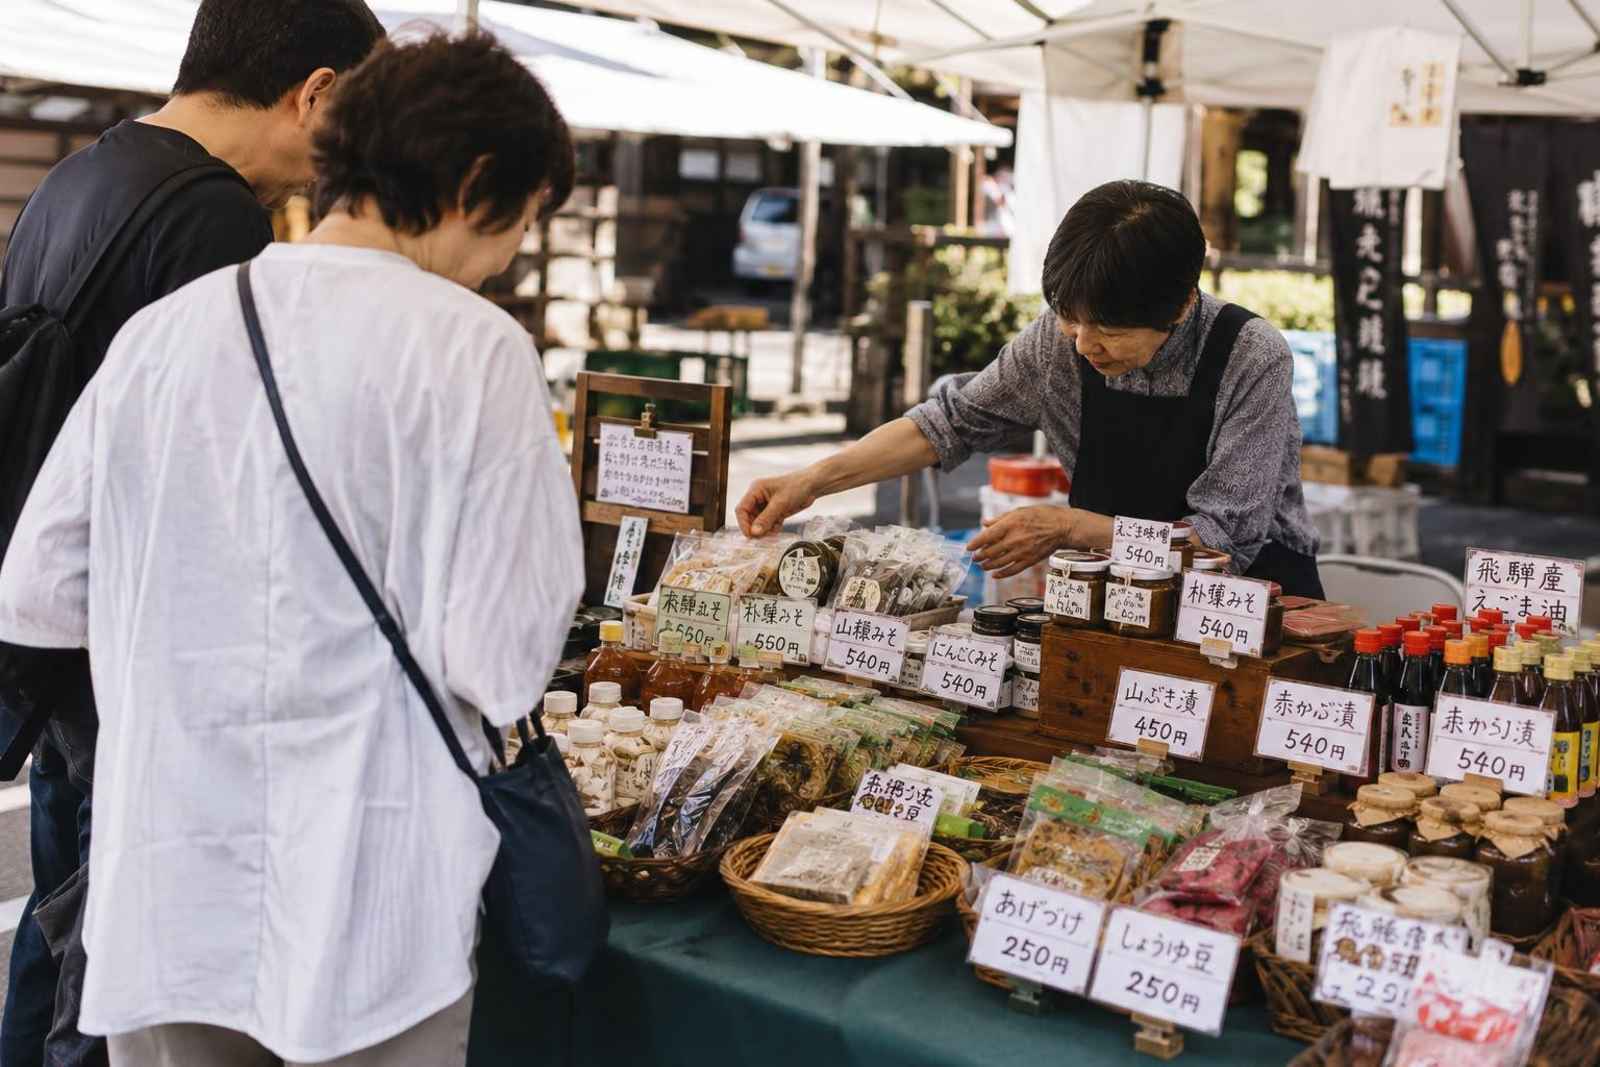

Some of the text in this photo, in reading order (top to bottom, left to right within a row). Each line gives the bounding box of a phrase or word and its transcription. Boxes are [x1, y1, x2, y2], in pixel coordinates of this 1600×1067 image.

[1126, 545, 1165, 568] 540円
[1199, 615, 1248, 643] 540円
[845, 647, 890, 674] 540円
[940, 671, 987, 699] 540円
[1124, 682, 1200, 717] 山ぶき漬
[1274, 690, 1358, 730] 赤かぶ漬
[1134, 716, 1188, 747] 450円
[1284, 728, 1345, 761] 540円
[1457, 747, 1526, 782] 540円
[994, 888, 1085, 936] あげづけ
[1001, 935, 1069, 976] 250円
[1120, 923, 1214, 976] しょうゆ豆
[1124, 971, 1201, 1014] 250円
